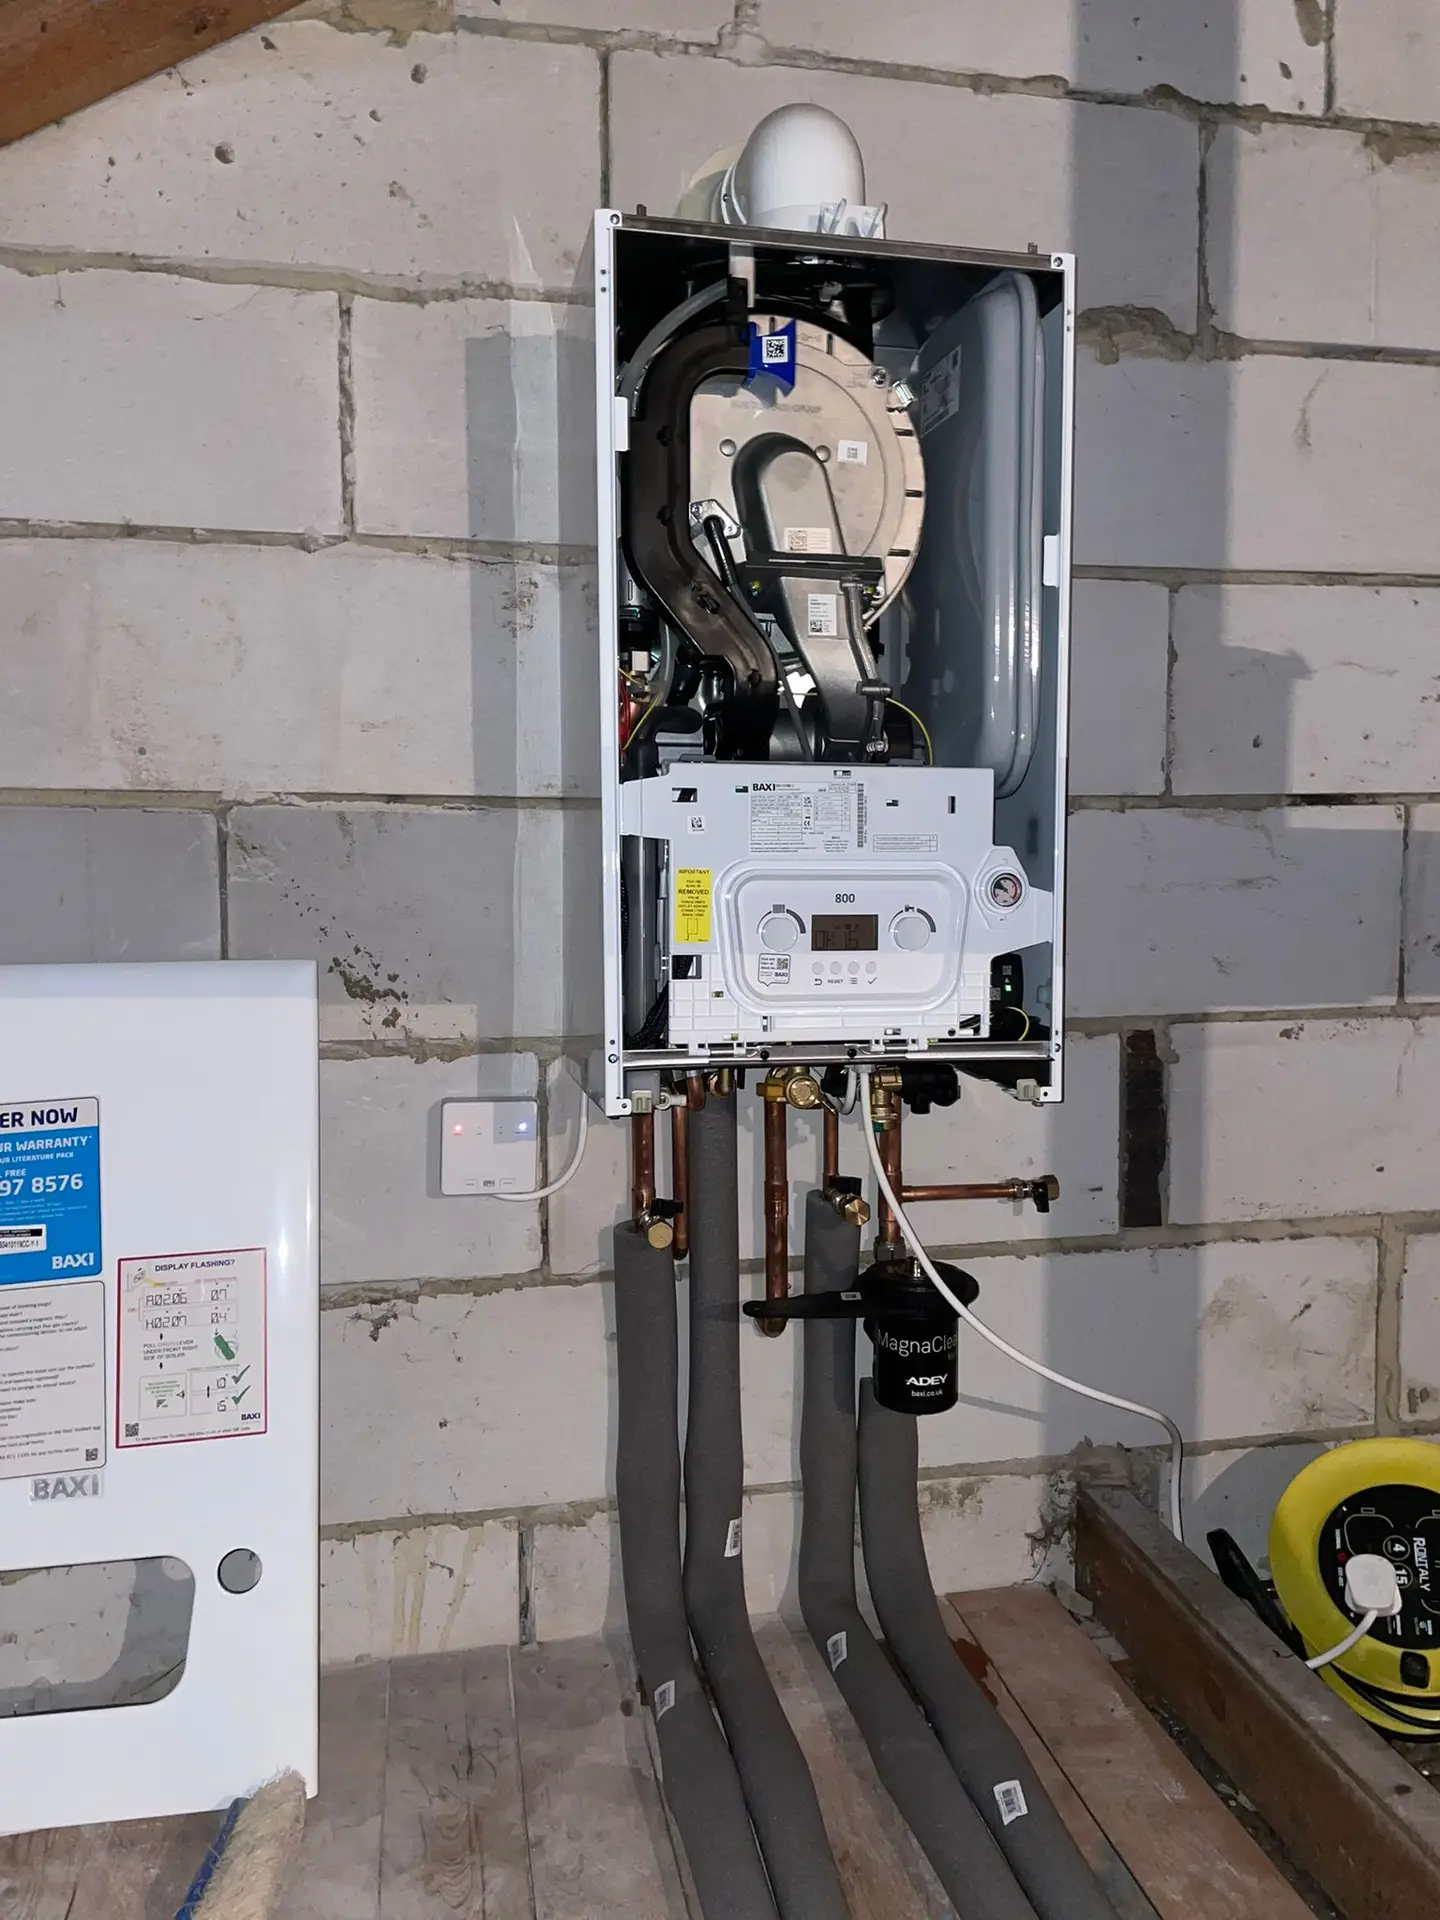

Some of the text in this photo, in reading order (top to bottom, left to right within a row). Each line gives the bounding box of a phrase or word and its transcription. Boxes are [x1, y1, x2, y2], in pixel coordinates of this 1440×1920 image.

[752, 783, 776, 792] BAXI
[834, 893, 856, 904] 800
[31, 1107, 79, 1126] NOW
[12, 1153, 54, 1163] LITERATURE
[56, 1151, 74, 1159] PACK
[4, 1168, 27, 1178] FREE
[31, 1173, 84, 1194] 8576
[52, 1252, 94, 1270] BAXI
[155, 1259, 236, 1272] DISPLAY FLASHING?
[905, 1373, 948, 1386] ADEY
[911, 1388, 943, 1397] baxi.co.uk
[241, 1412, 261, 1421] BAXI
[33, 1474, 99, 1500] BAXI
[1393, 1543, 1406, 1553] 4
[1396, 1568, 1408, 1585] 15
